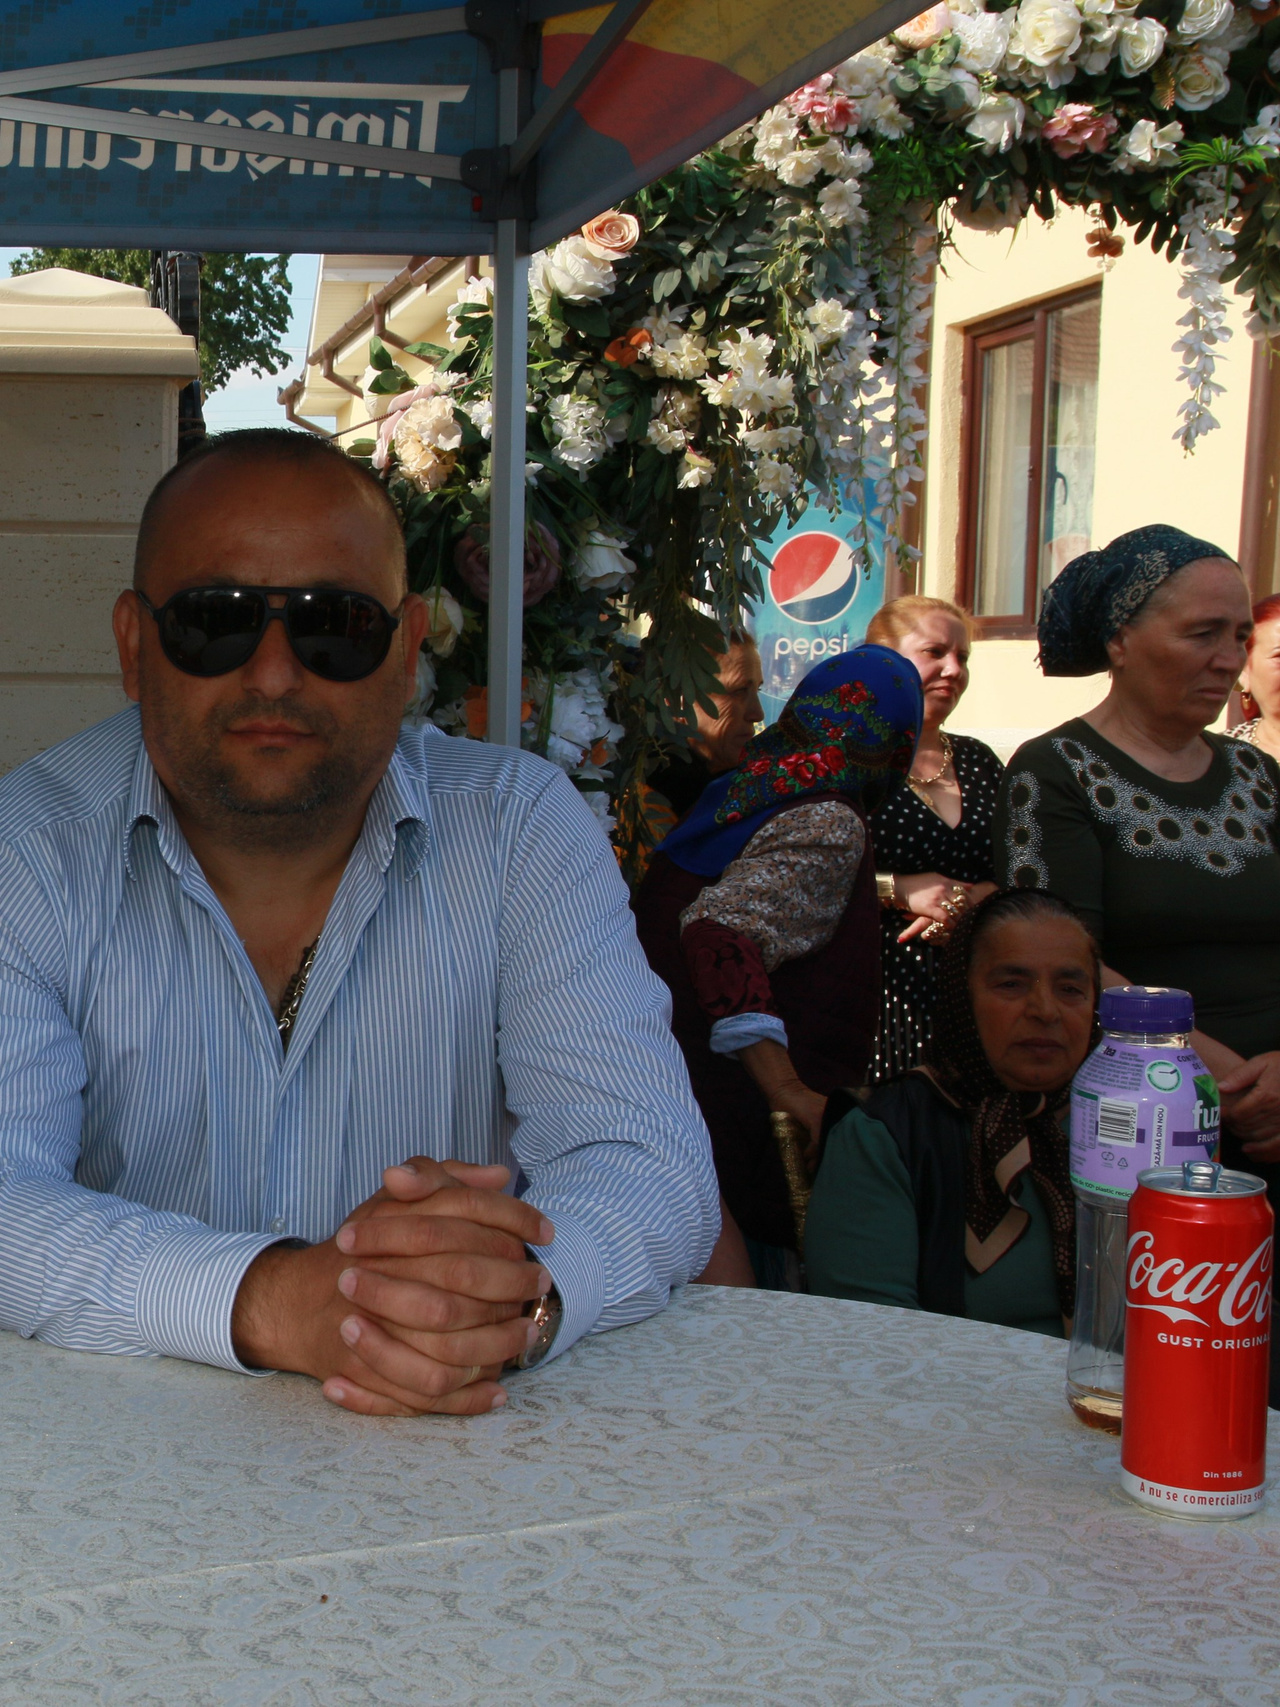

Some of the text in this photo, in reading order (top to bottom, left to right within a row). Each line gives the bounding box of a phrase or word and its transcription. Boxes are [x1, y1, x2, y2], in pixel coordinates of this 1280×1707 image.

[774, 633, 849, 661] pepsi
[1157, 1332, 1204, 1349] GUST
[1139, 1482, 1146, 1493] A
[1149, 1486, 1161, 1498] nu
[1166, 1491, 1178, 1502] se
[1183, 1493, 1252, 1506] comercializa
